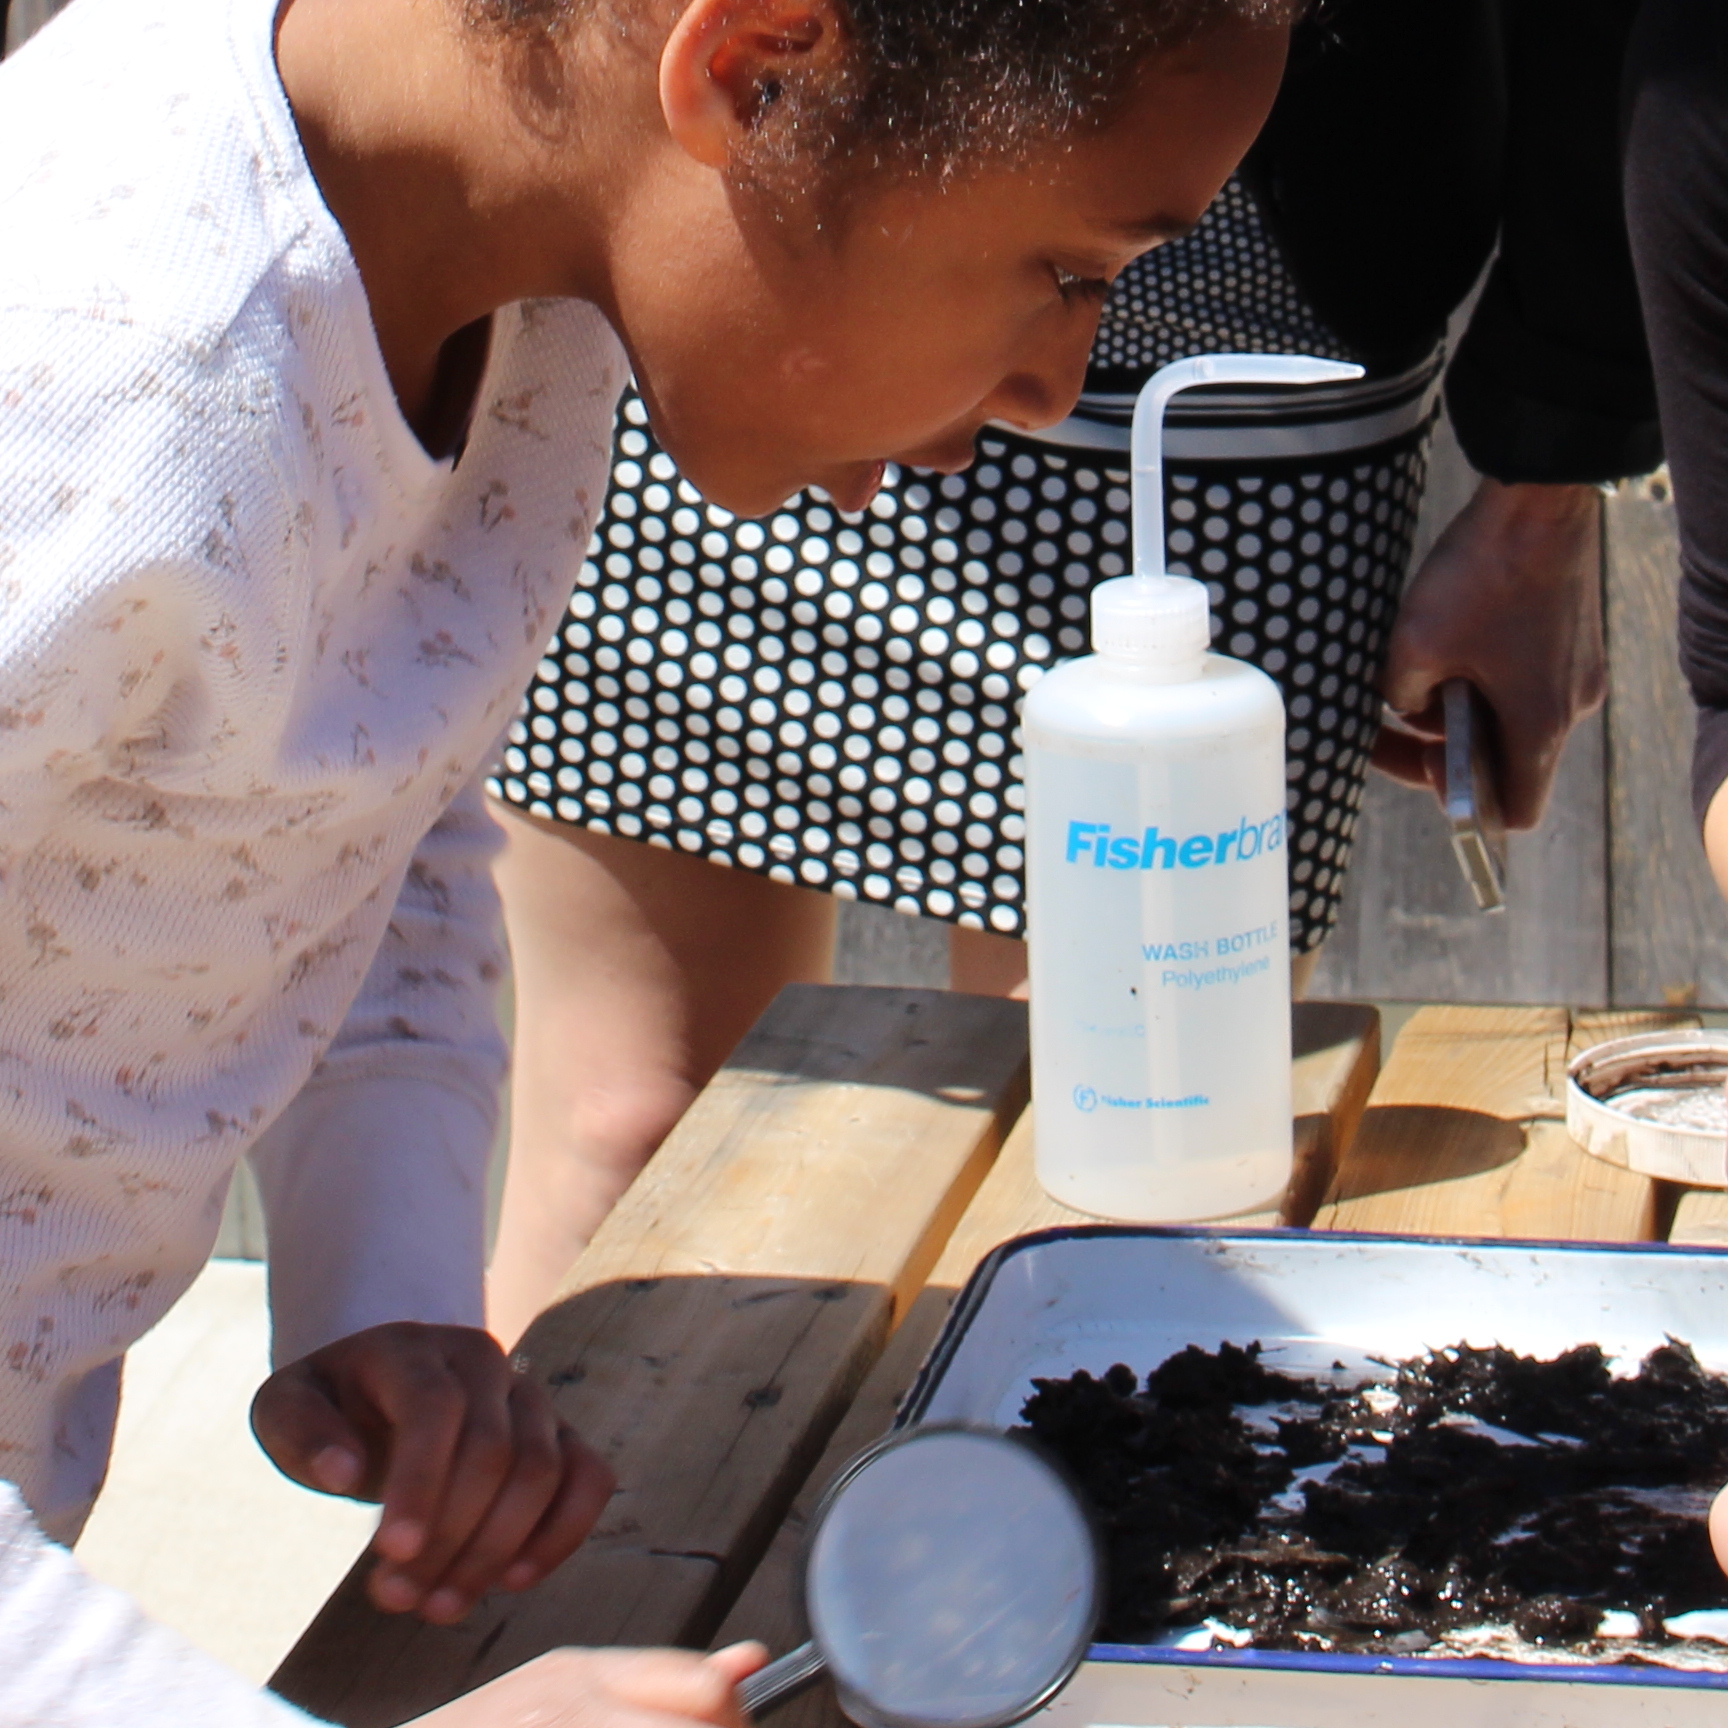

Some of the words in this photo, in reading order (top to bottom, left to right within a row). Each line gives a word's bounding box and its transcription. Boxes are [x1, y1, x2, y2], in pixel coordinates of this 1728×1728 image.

[1066, 810, 1286, 869] Fisherbra
[1142, 940, 1209, 962] WASH
[1216, 921, 1278, 956] BOTTLE
[1161, 956, 1271, 991] Polyethylene
[1146, 1094, 1210, 1109] Scientific
